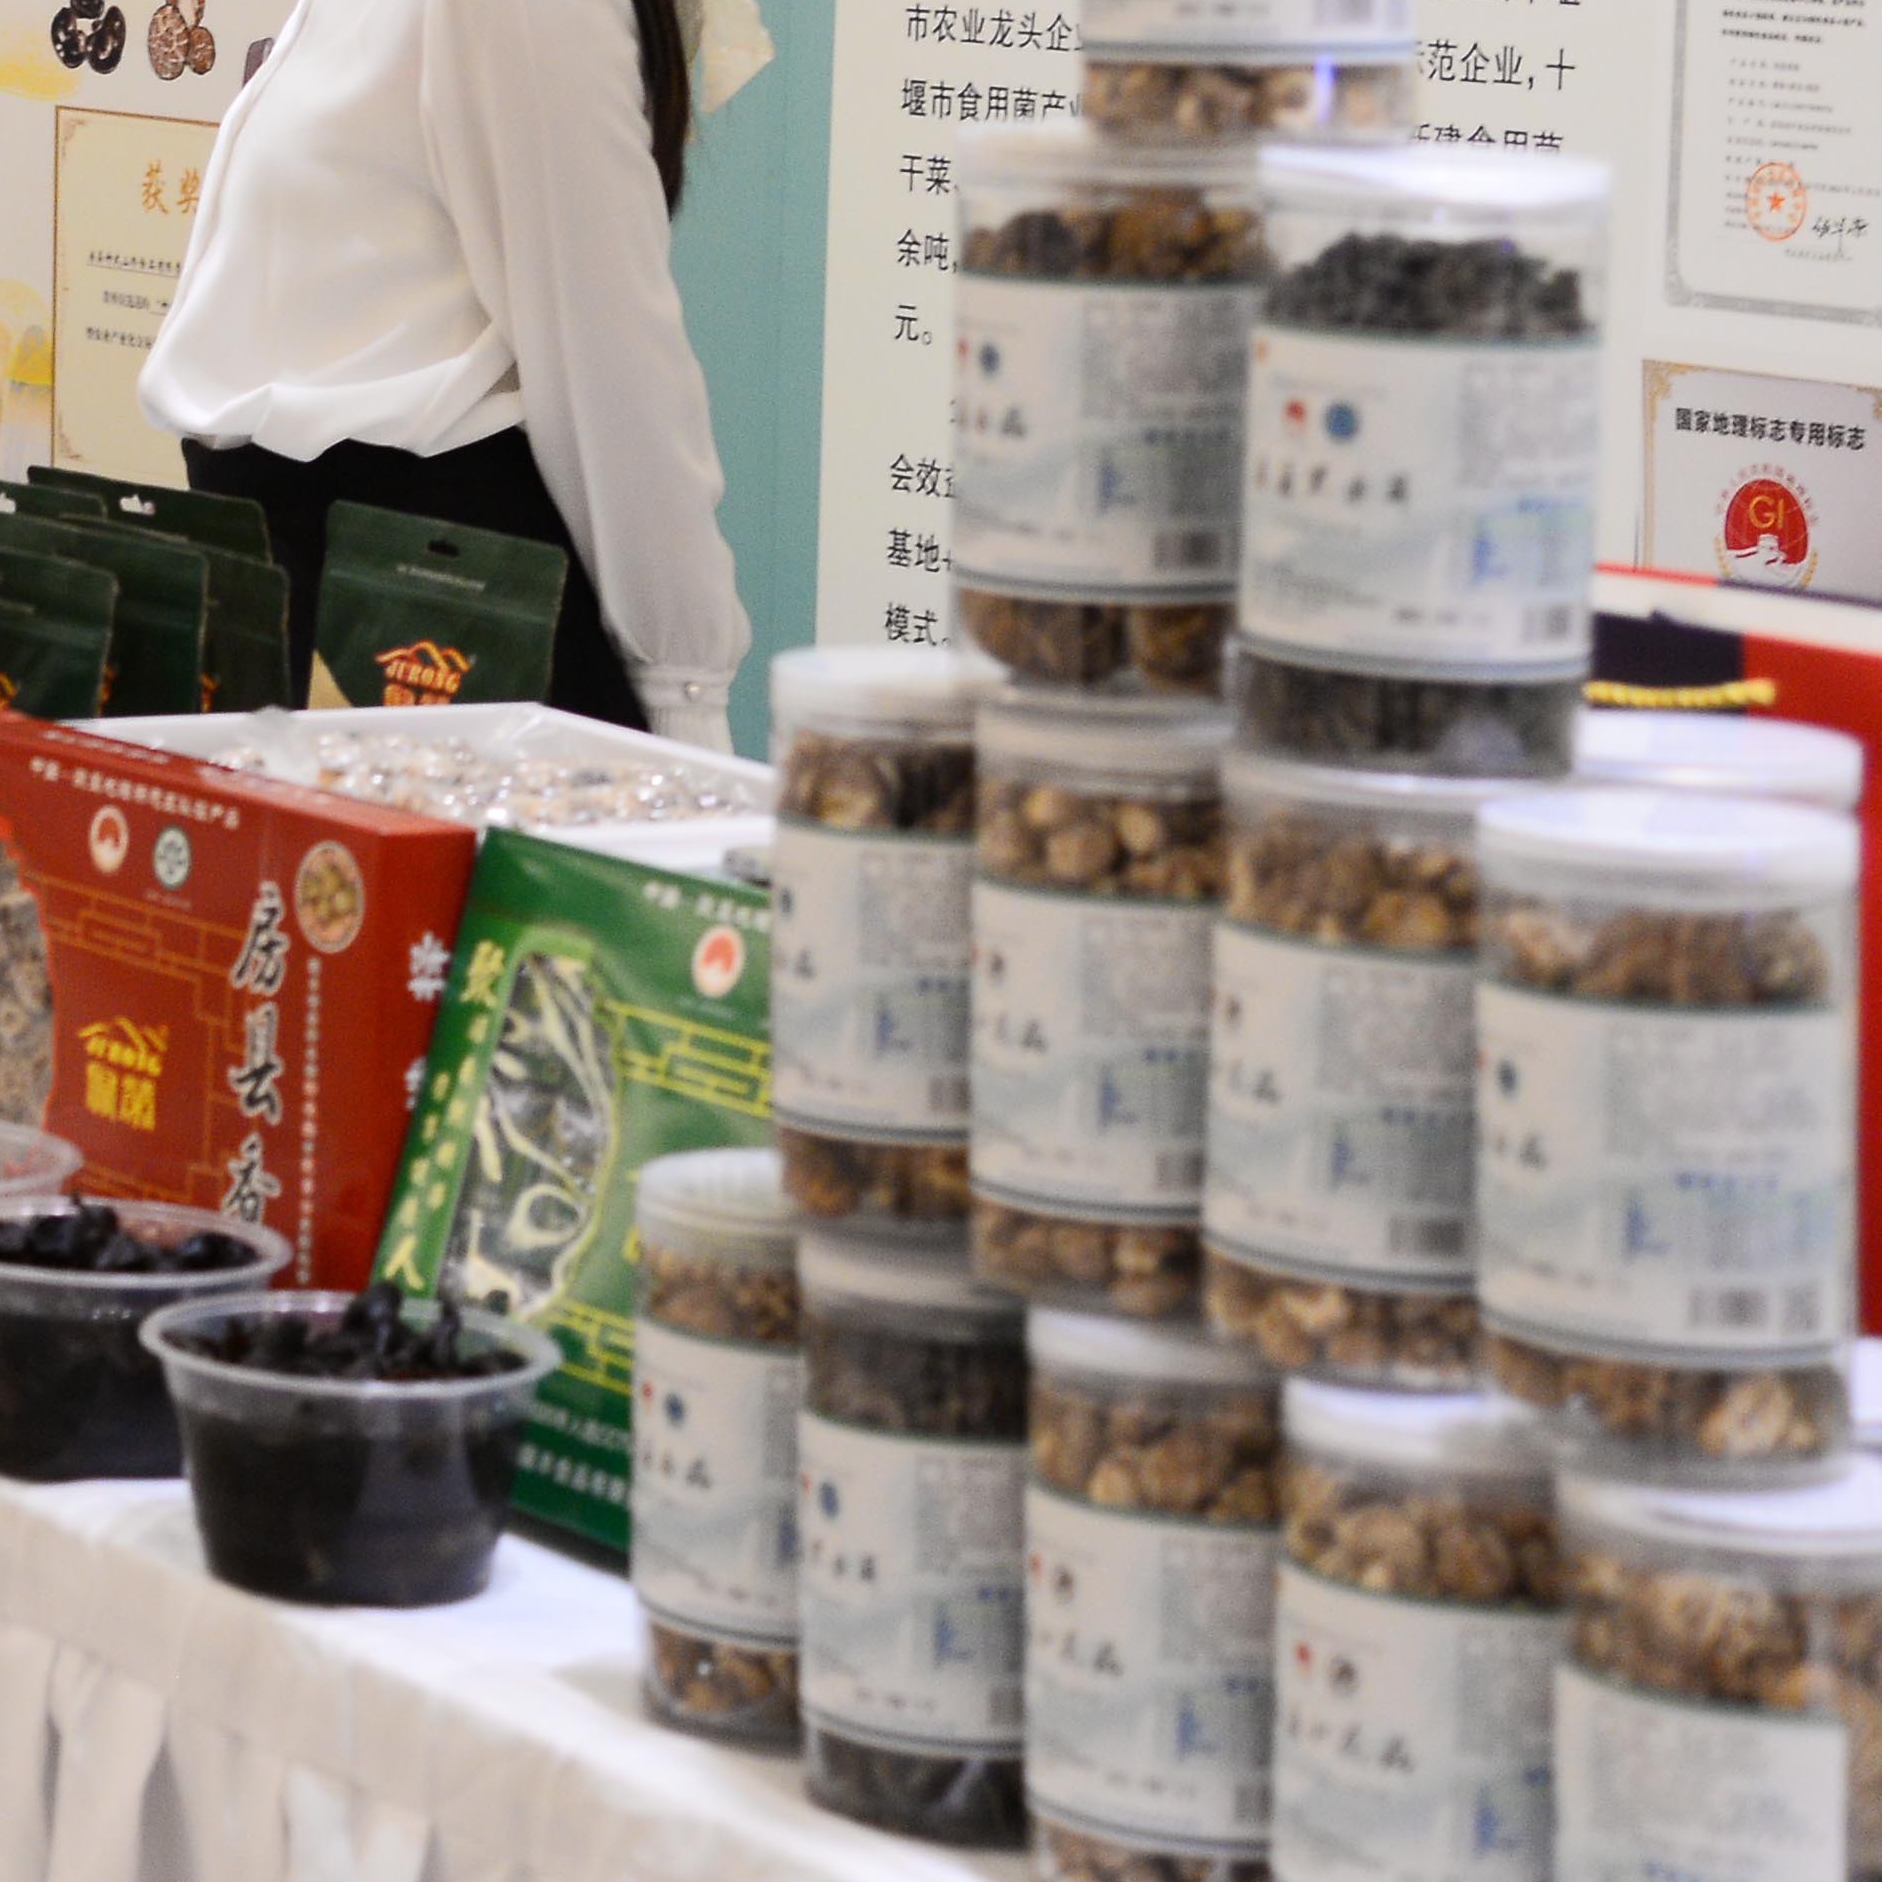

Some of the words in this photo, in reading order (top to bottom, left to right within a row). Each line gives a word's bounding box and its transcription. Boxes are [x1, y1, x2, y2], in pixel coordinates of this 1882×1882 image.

[894, 304, 934, 345] 元。
[1674, 405, 1867, 453] 国家地理标志专用标志
